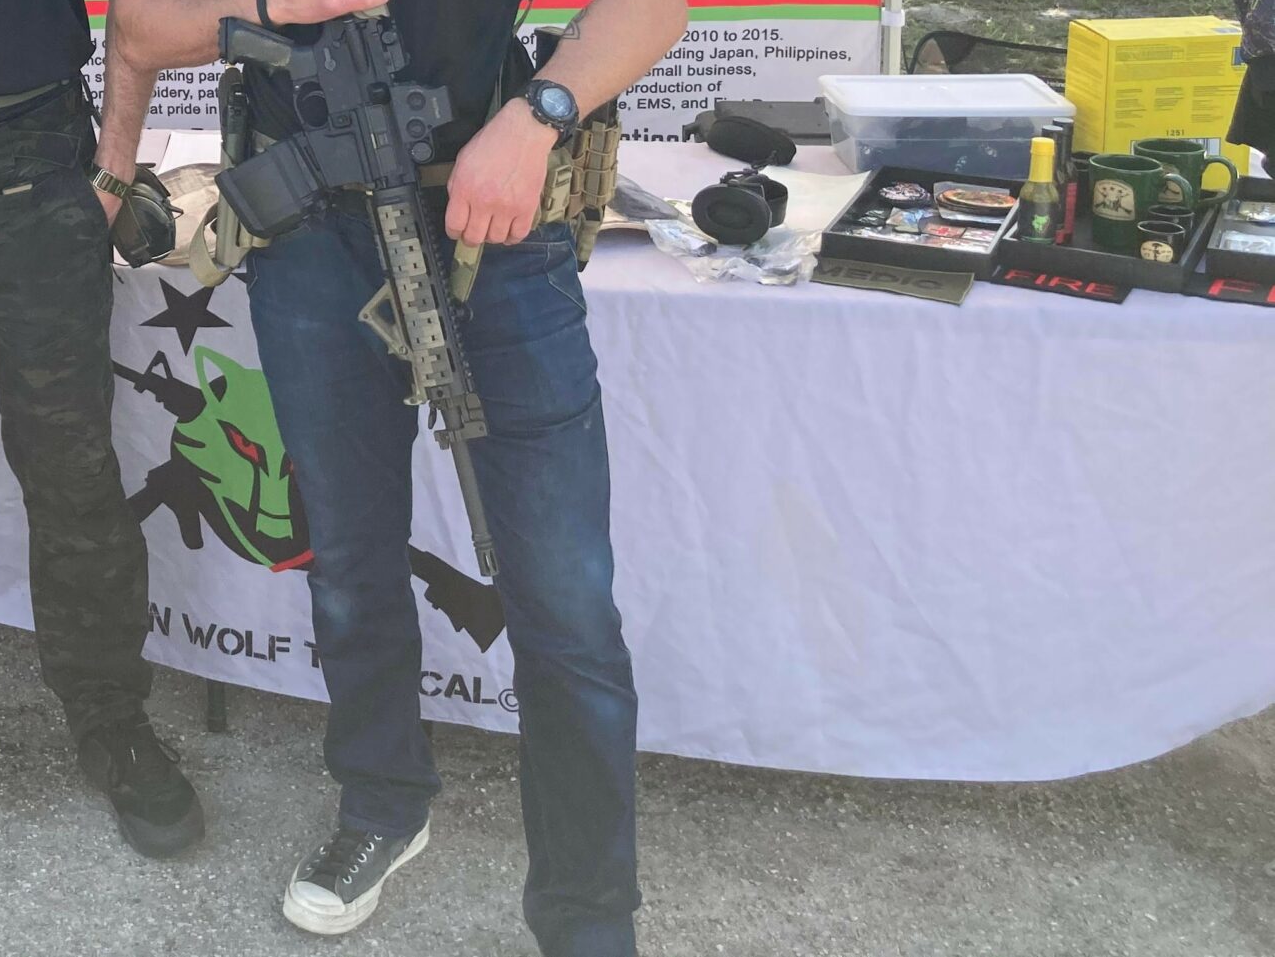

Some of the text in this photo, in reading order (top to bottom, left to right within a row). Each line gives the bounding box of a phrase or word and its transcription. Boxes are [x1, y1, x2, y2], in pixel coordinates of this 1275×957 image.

[521, 28, 784, 45] of 2010 to 2015.
[709, 47, 758, 61] Japan,
[764, 46, 852, 62] Philippines,
[158, 69, 194, 84] aking
[687, 63, 756, 77] business,
[626, 81, 702, 96] production
[706, 80, 723, 92] of
[167, 103, 201, 117] pride
[205, 103, 218, 115] in
[636, 97, 676, 111] EMS,
[680, 97, 708, 110] and
[1003, 269, 1119, 298] FIRE
[181, 612, 291, 663] WOLF
